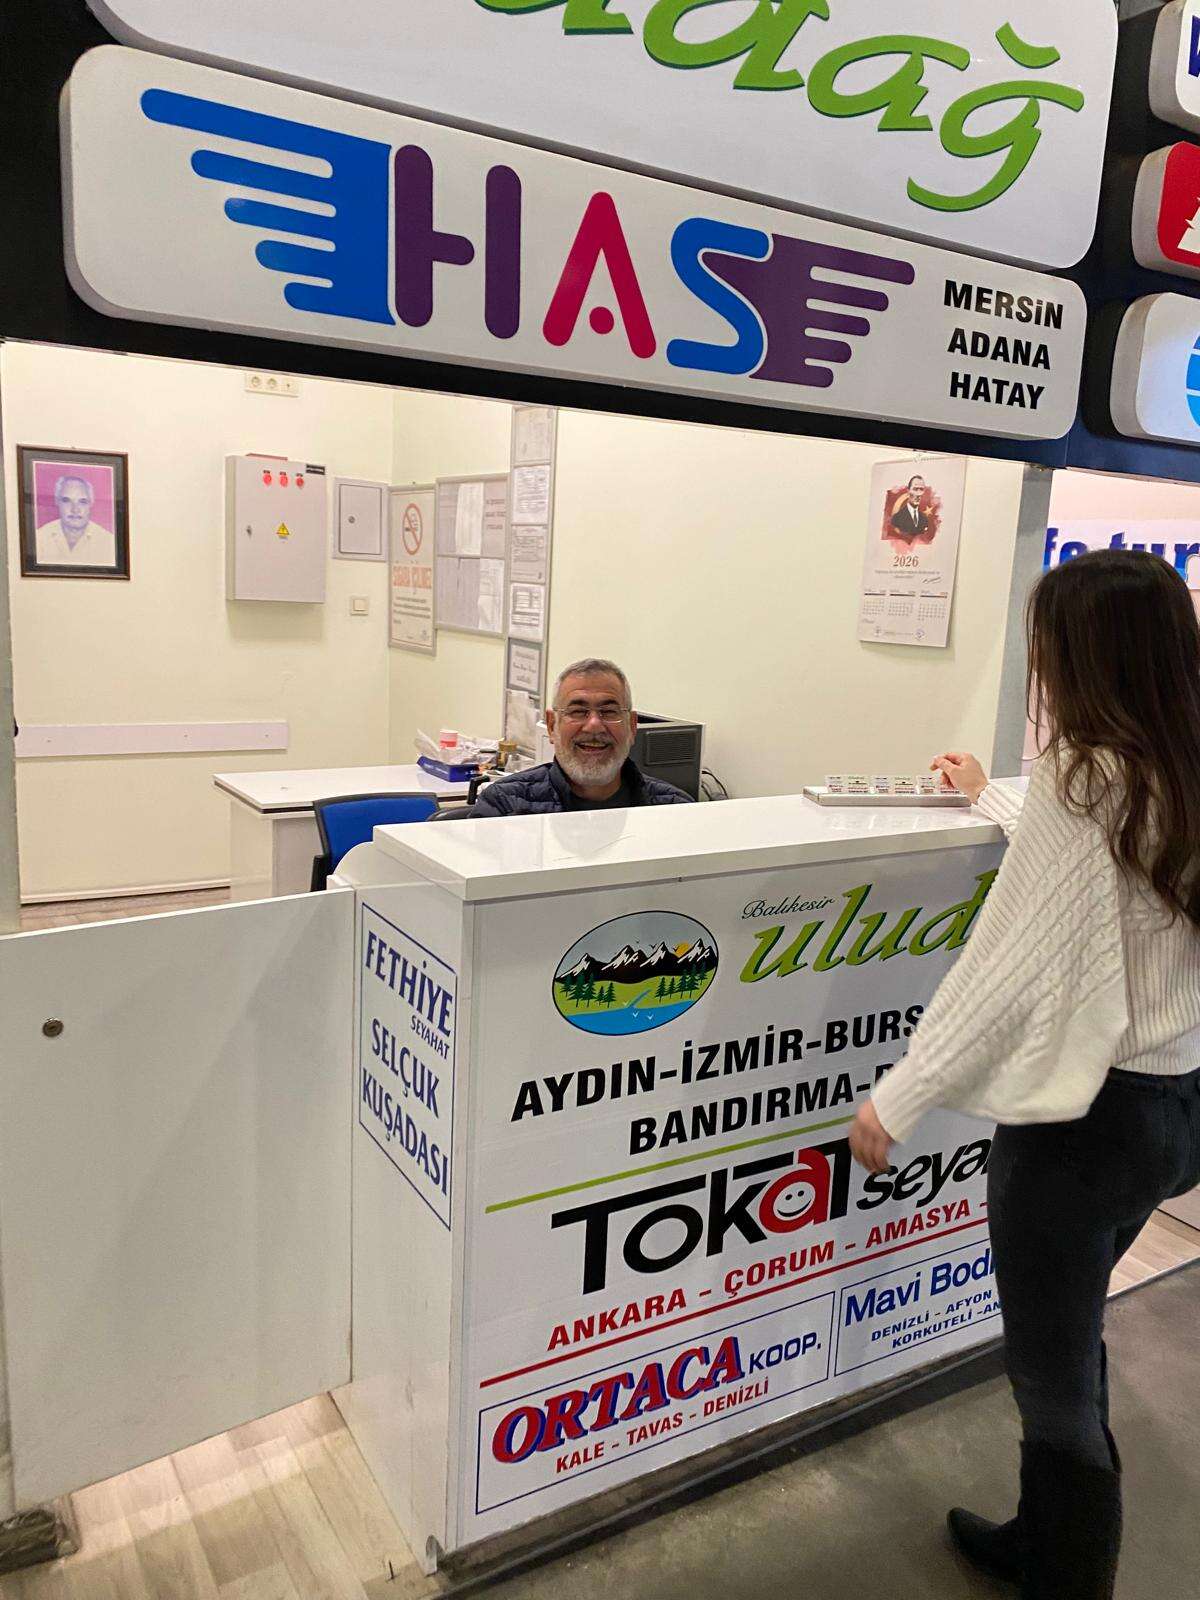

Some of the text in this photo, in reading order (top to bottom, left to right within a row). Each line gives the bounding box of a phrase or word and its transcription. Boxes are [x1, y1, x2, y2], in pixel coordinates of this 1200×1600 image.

[394, 144, 769, 375] HAS
[947, 327, 1051, 370] ADANA
[949, 371, 1045, 409] HATAY
[893, 555, 919, 567] 2026
[741, 895, 835, 919] Balıkesir
[365, 930, 453, 1037] FETHİYE
[371, 1017, 440, 1119] SELÇUK
[410, 1014, 450, 1060] SEYAHAT
[362, 1067, 449, 1196] KUŞADASI
[547, 1287, 688, 1351] ANKARA
[723, 1239, 836, 1299] ÇORUM
[865, 1198, 971, 1249] AMASYA
[844, 1248, 994, 1328] Mavi Bod
[871, 1310, 930, 1342] DENİZLİ
[945, 1289, 993, 1315] AFYON
[892, 1310, 972, 1349] KORKUTELİ
[491, 1331, 822, 1465] ORTACA KOOP.
[556, 1444, 606, 1474] KALE
[626, 1411, 684, 1448] TAVAS
[703, 1376, 770, 1418] DENİZLİ
